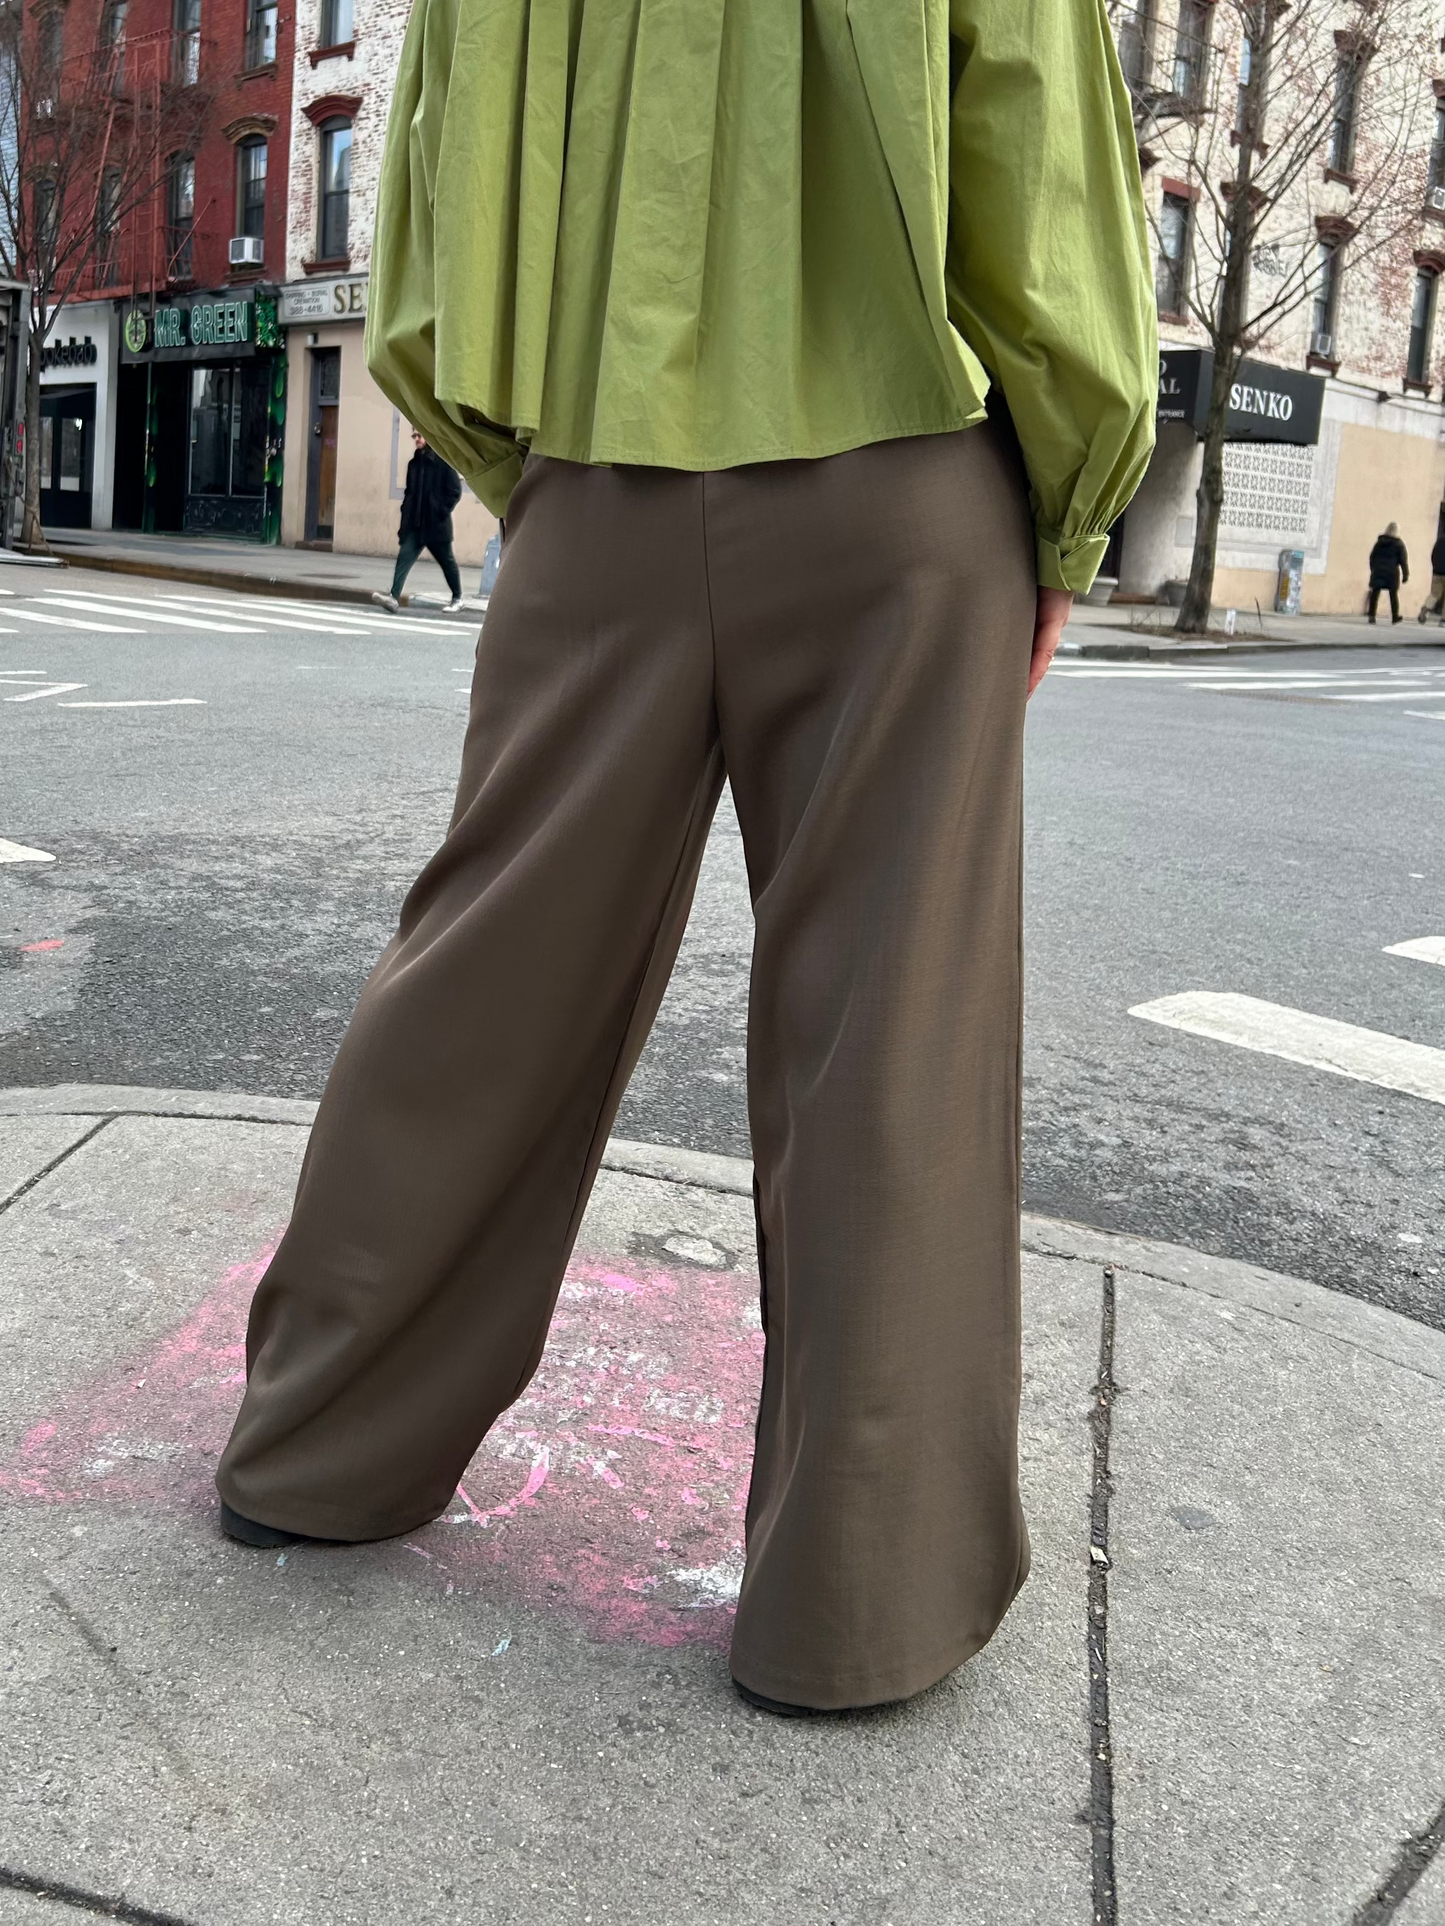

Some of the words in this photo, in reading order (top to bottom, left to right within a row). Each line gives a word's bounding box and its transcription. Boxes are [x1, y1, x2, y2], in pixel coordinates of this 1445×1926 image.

[154, 307, 186, 348] MR.
[190, 301, 248, 345] GREEN
[1229, 383, 1293, 421] SENKO
